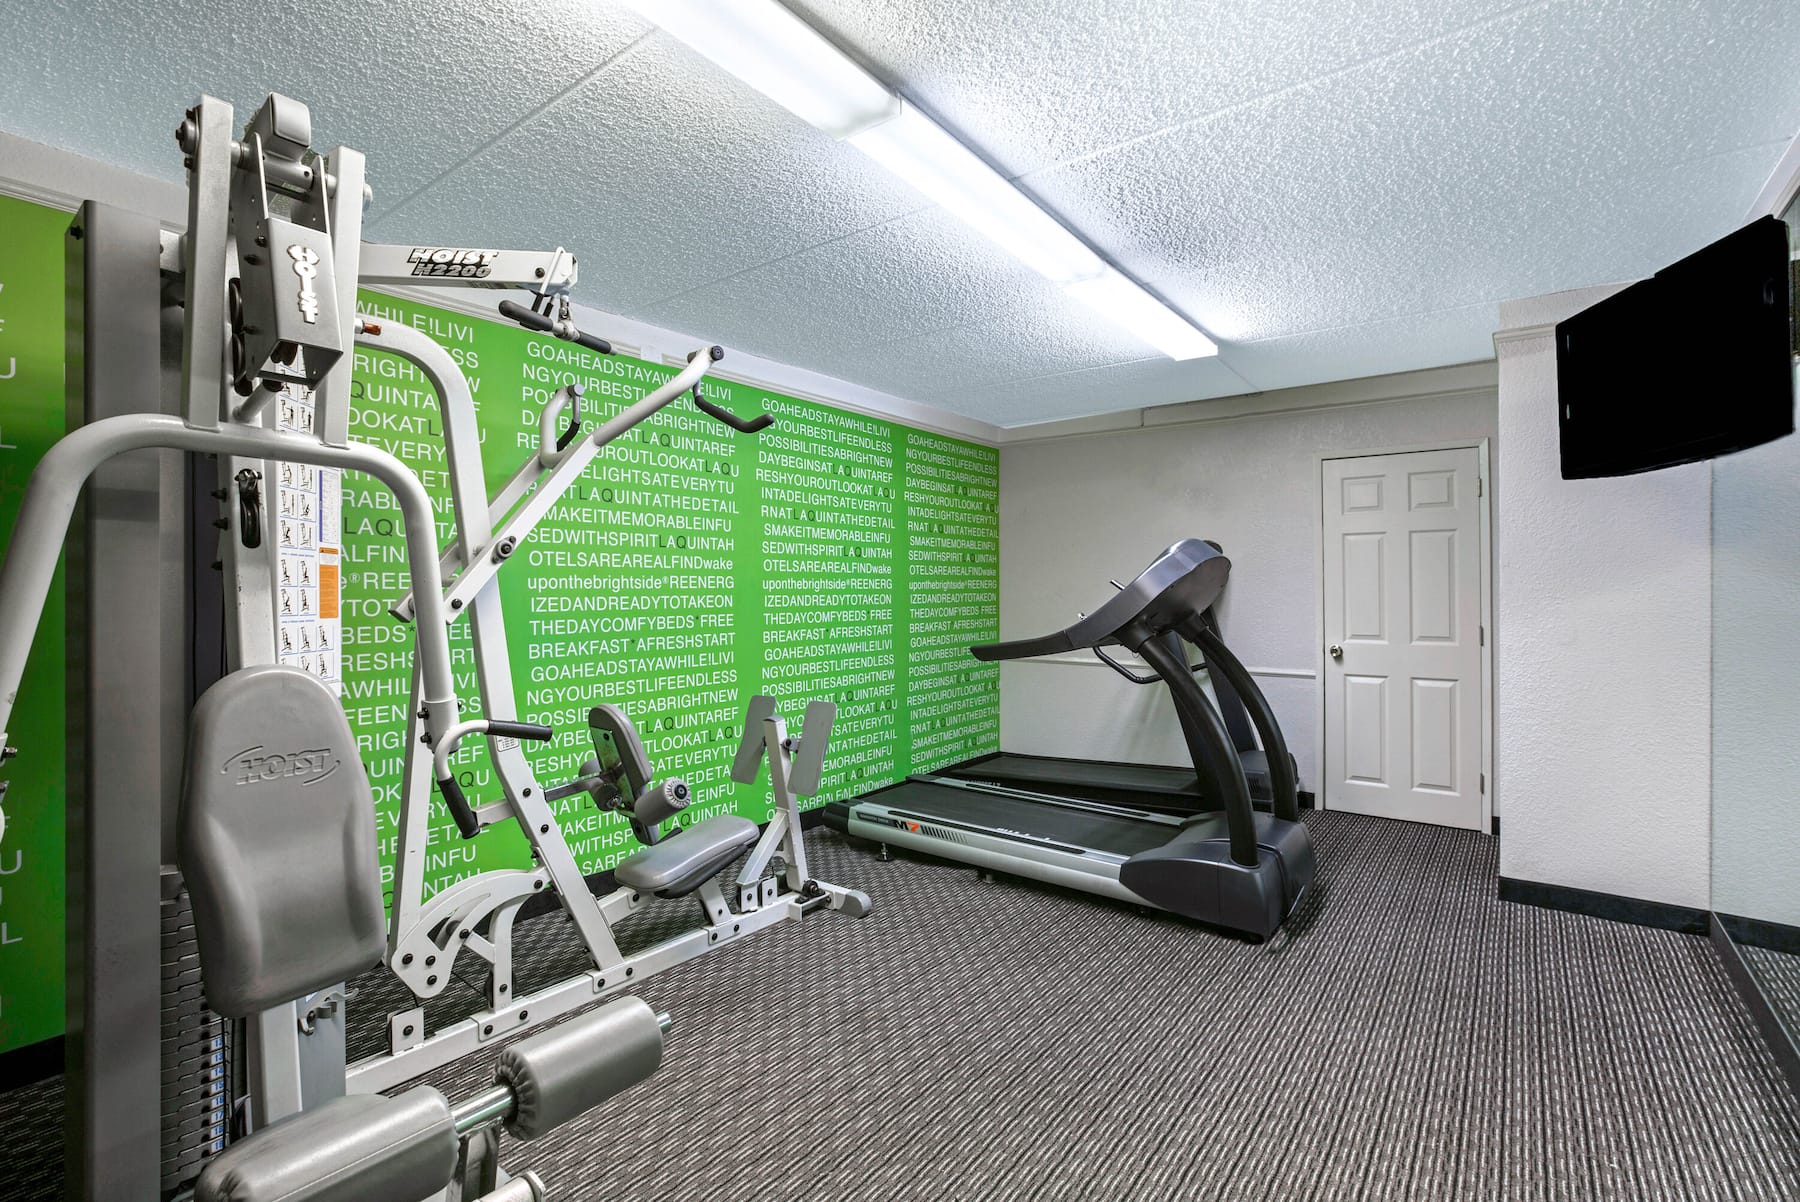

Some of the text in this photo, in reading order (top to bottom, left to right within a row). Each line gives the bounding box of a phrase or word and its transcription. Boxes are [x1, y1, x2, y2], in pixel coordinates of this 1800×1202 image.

[408, 248, 499, 268] HOIST
[411, 263, 492, 279] H2200
[759, 433, 893, 468] POSSIBILITIESABRIGHTNEW
[531, 595, 733, 612] IZEDANDREADYTOTAKEON
[527, 670, 737, 706] NGYOURBESTLIFEENDLESS
[236, 749, 331, 785] HOIST
